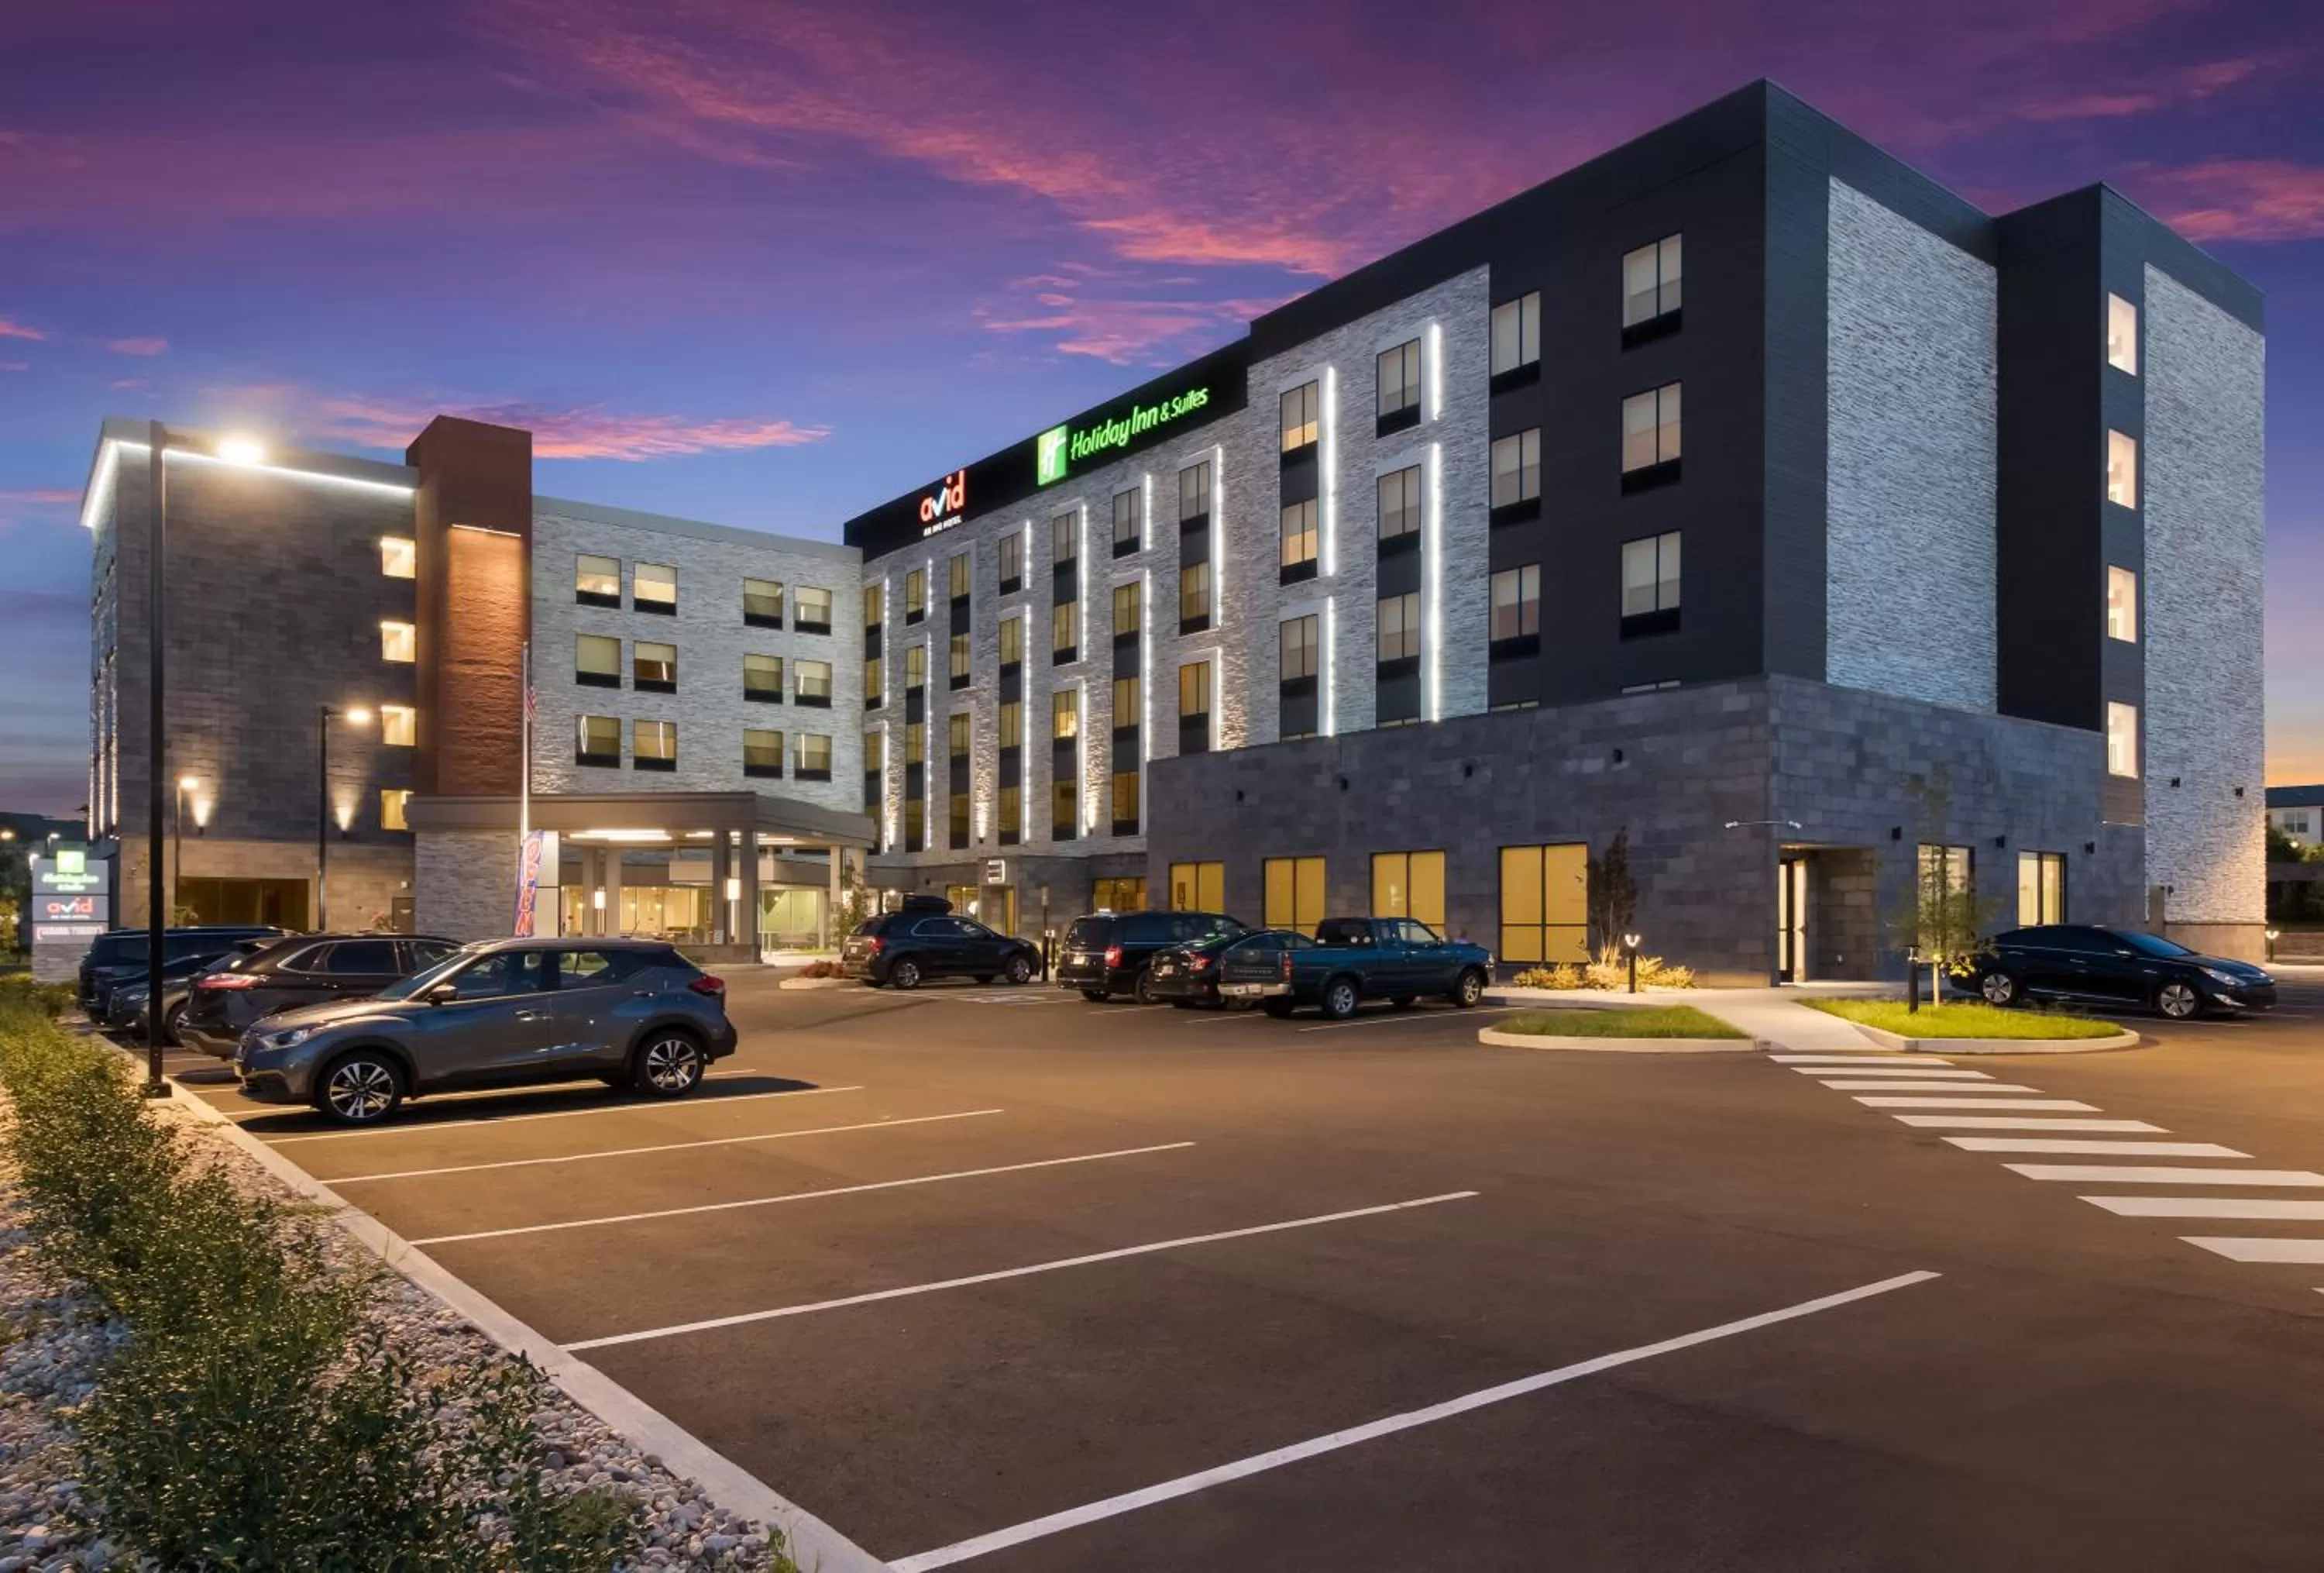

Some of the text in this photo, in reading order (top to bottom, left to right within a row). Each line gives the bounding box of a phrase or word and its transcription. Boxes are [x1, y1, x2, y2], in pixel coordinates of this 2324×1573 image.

[1071, 388, 1208, 460] Holiday Inn & Suites
[920, 470, 964, 521] avid
[47, 897, 92, 914] avid
